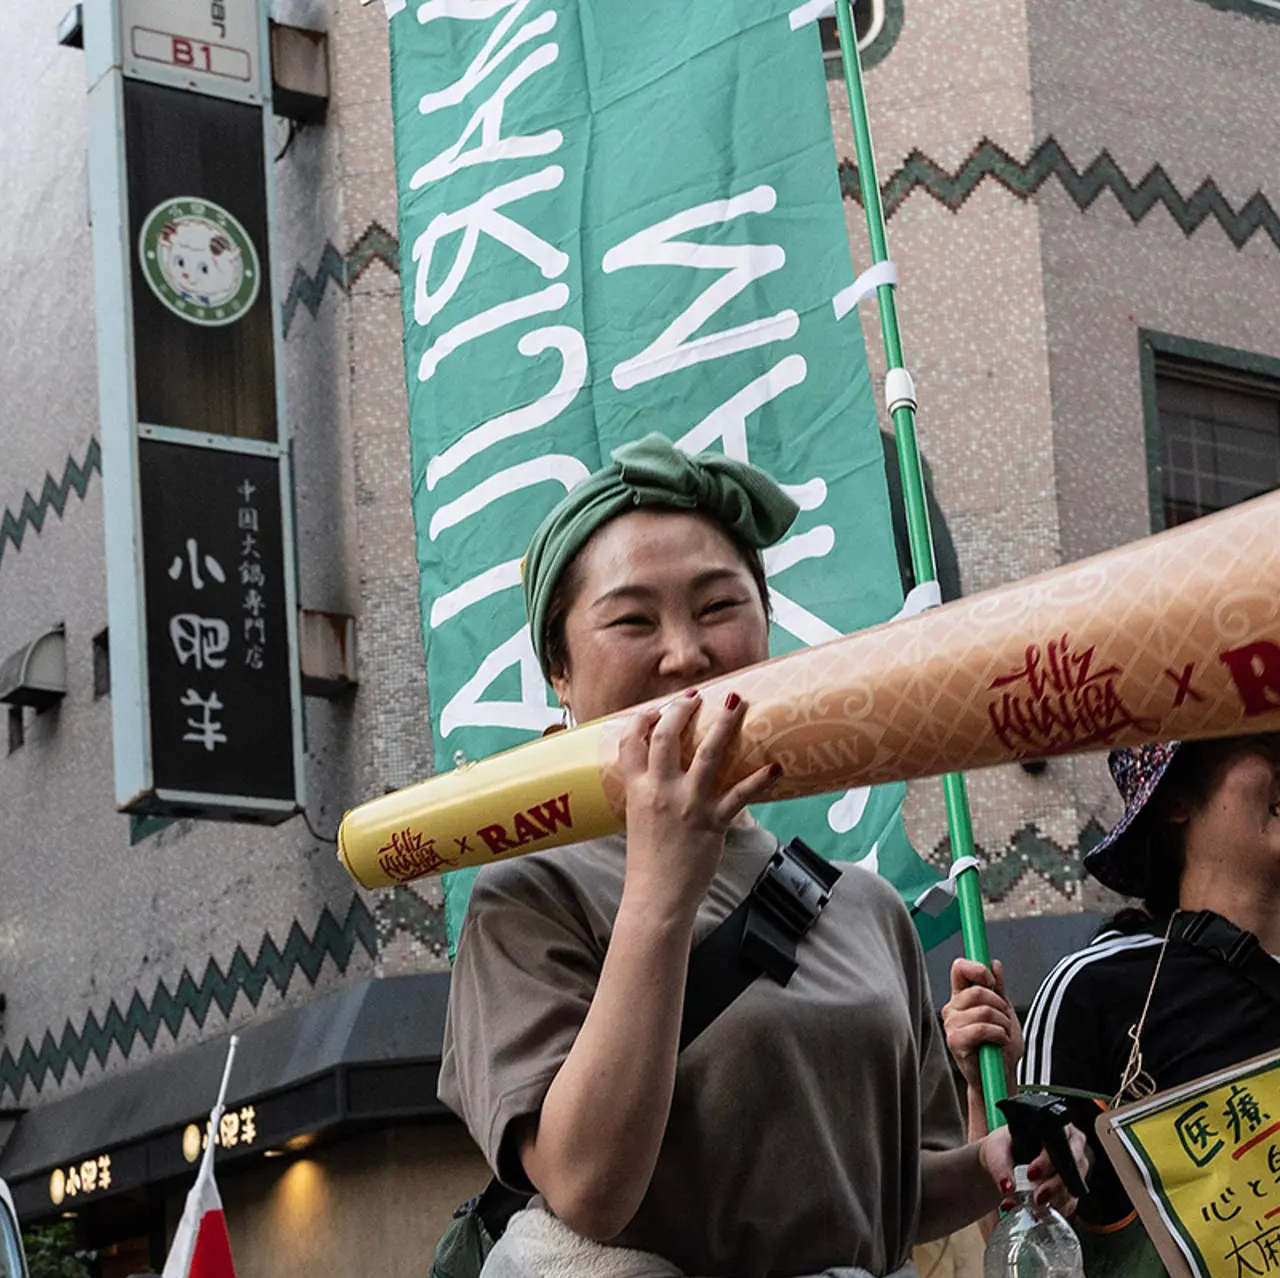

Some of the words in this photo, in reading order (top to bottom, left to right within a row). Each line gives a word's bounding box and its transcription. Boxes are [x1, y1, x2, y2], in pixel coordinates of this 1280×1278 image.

[171, 38, 212, 73] B1
[777, 736, 860, 778] RAW
[477, 792, 574, 856] RAW
